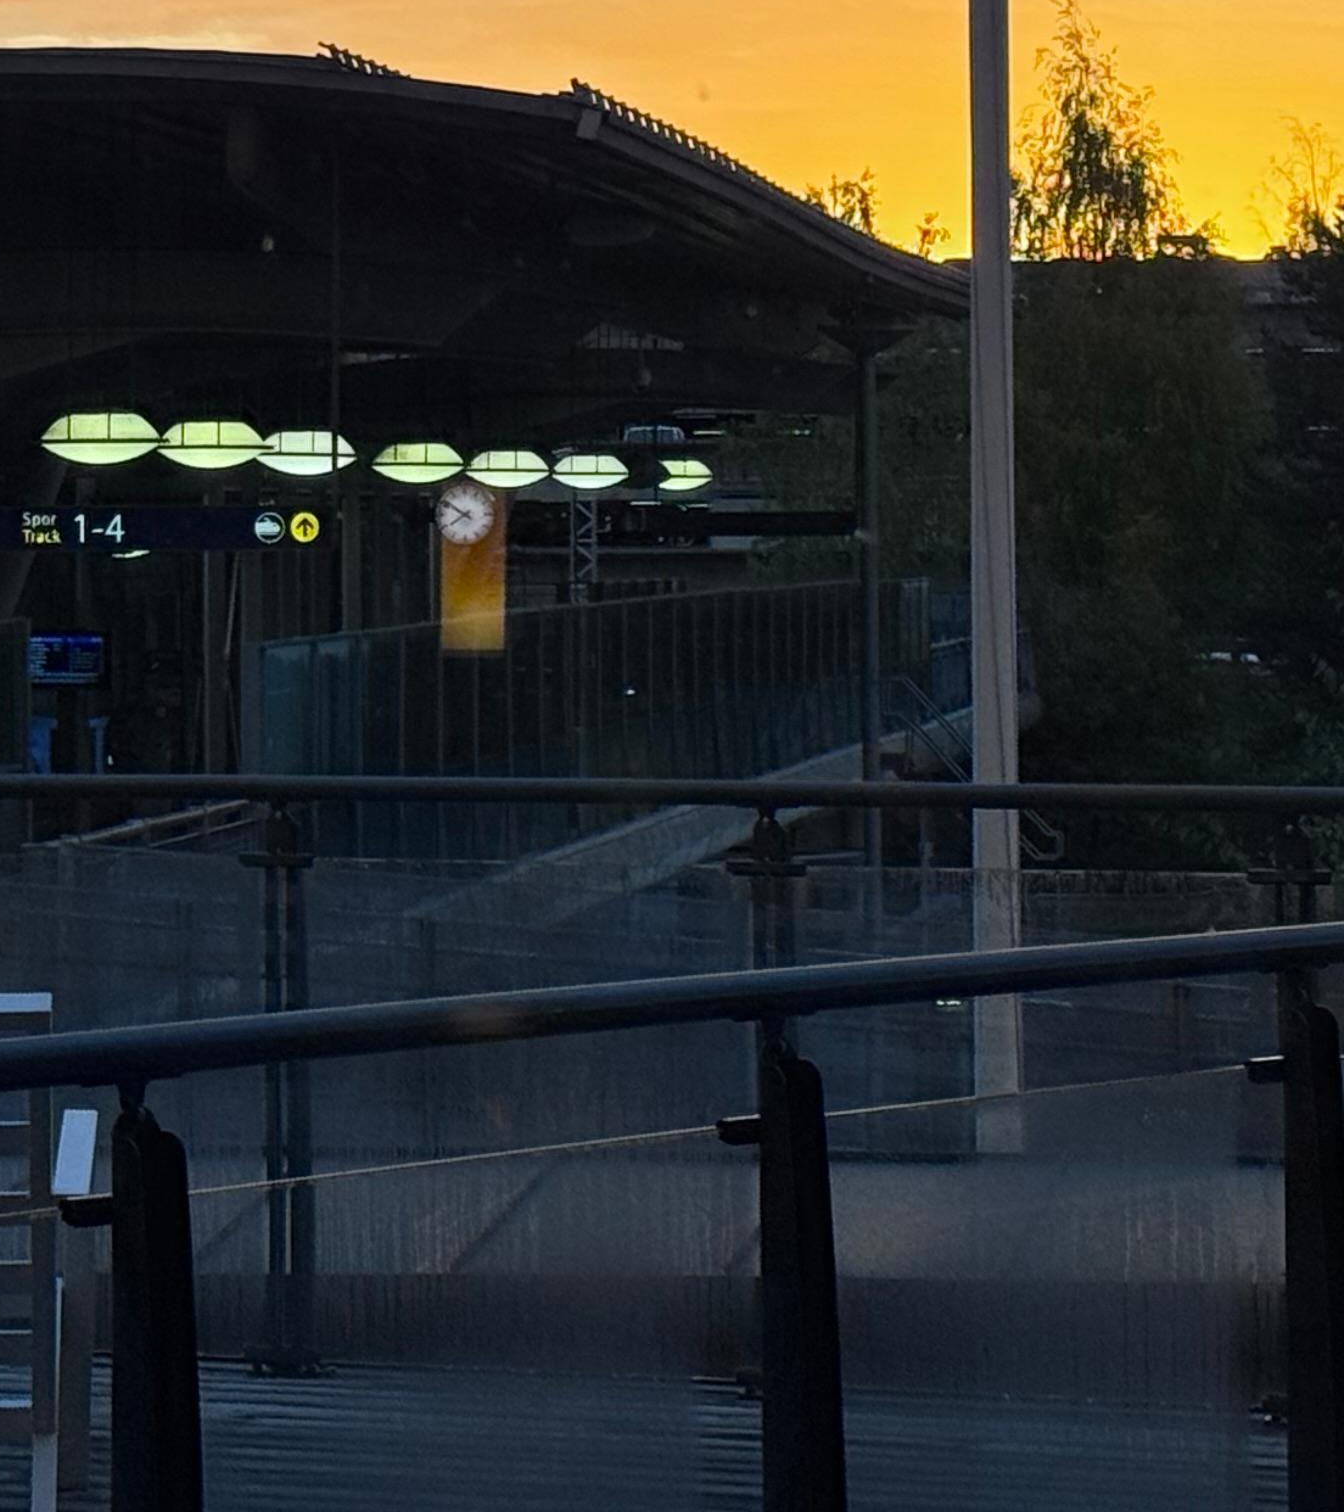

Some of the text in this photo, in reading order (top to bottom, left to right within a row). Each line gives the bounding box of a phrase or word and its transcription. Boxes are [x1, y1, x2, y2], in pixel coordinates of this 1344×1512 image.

[21, 511, 58, 528] Spor
[21, 528, 62, 544] Track
[73, 513, 126, 544] 1-4
